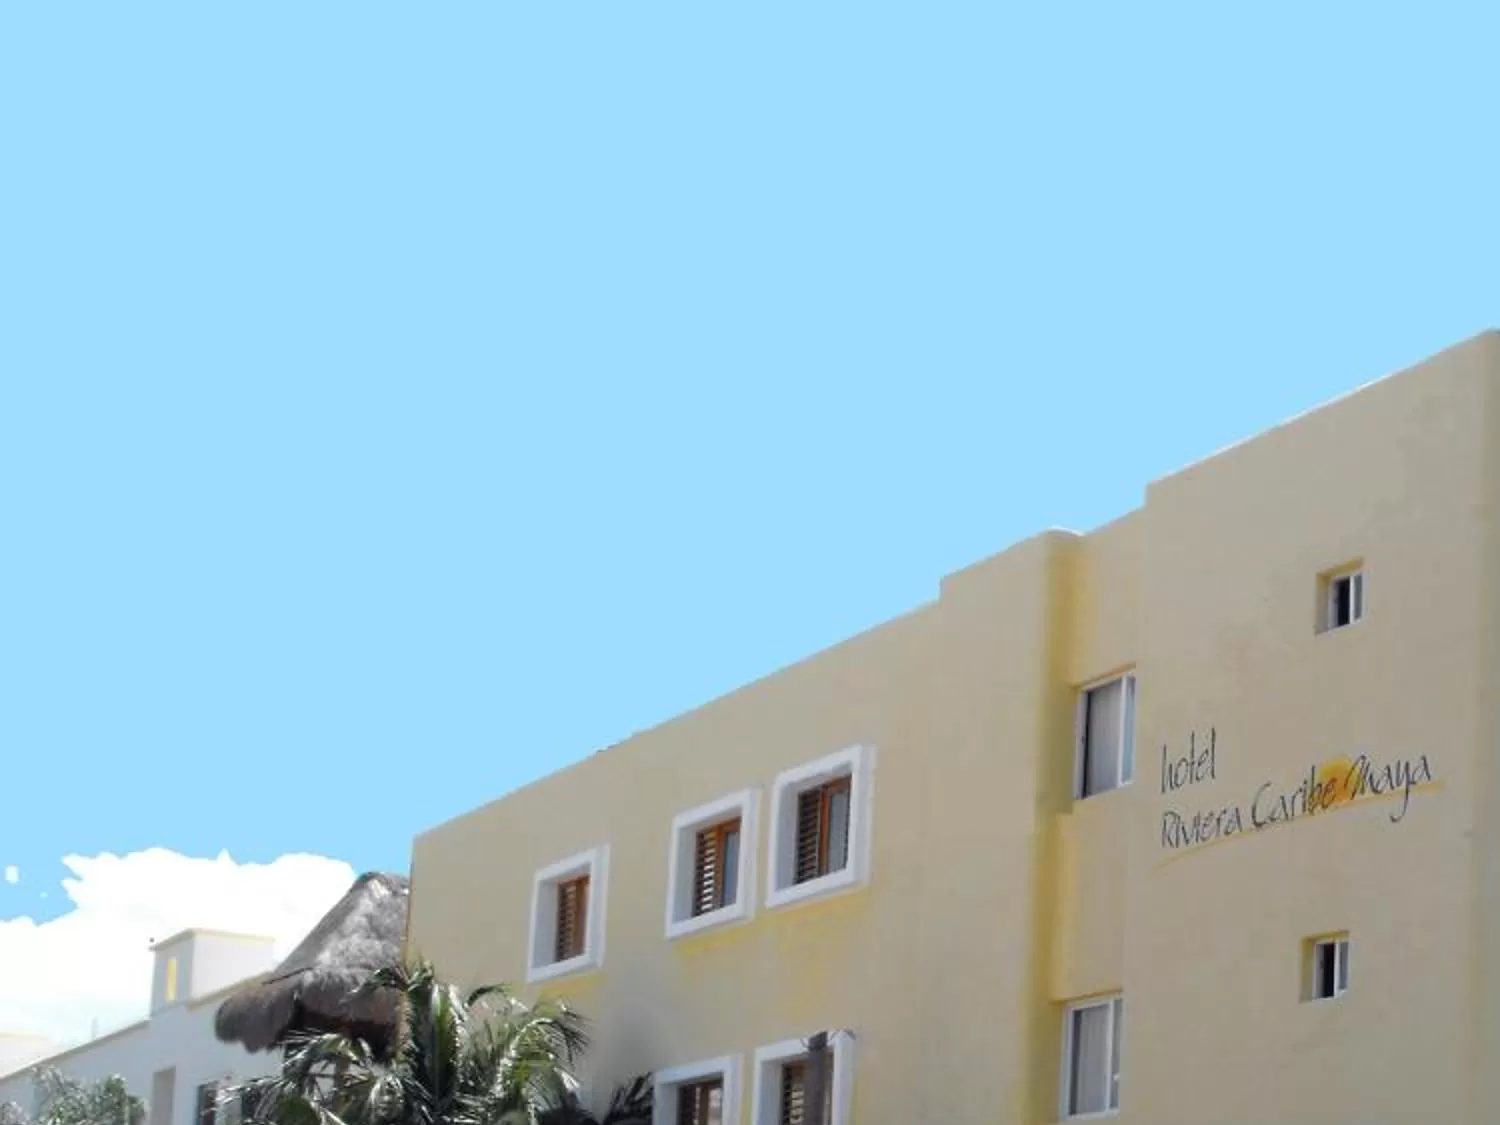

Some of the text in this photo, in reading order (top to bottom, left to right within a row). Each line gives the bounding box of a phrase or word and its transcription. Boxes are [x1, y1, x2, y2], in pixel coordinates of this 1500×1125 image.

[1161, 727, 1216, 794] hotel
[1161, 754, 1432, 848] Riviera Caribe Maya
